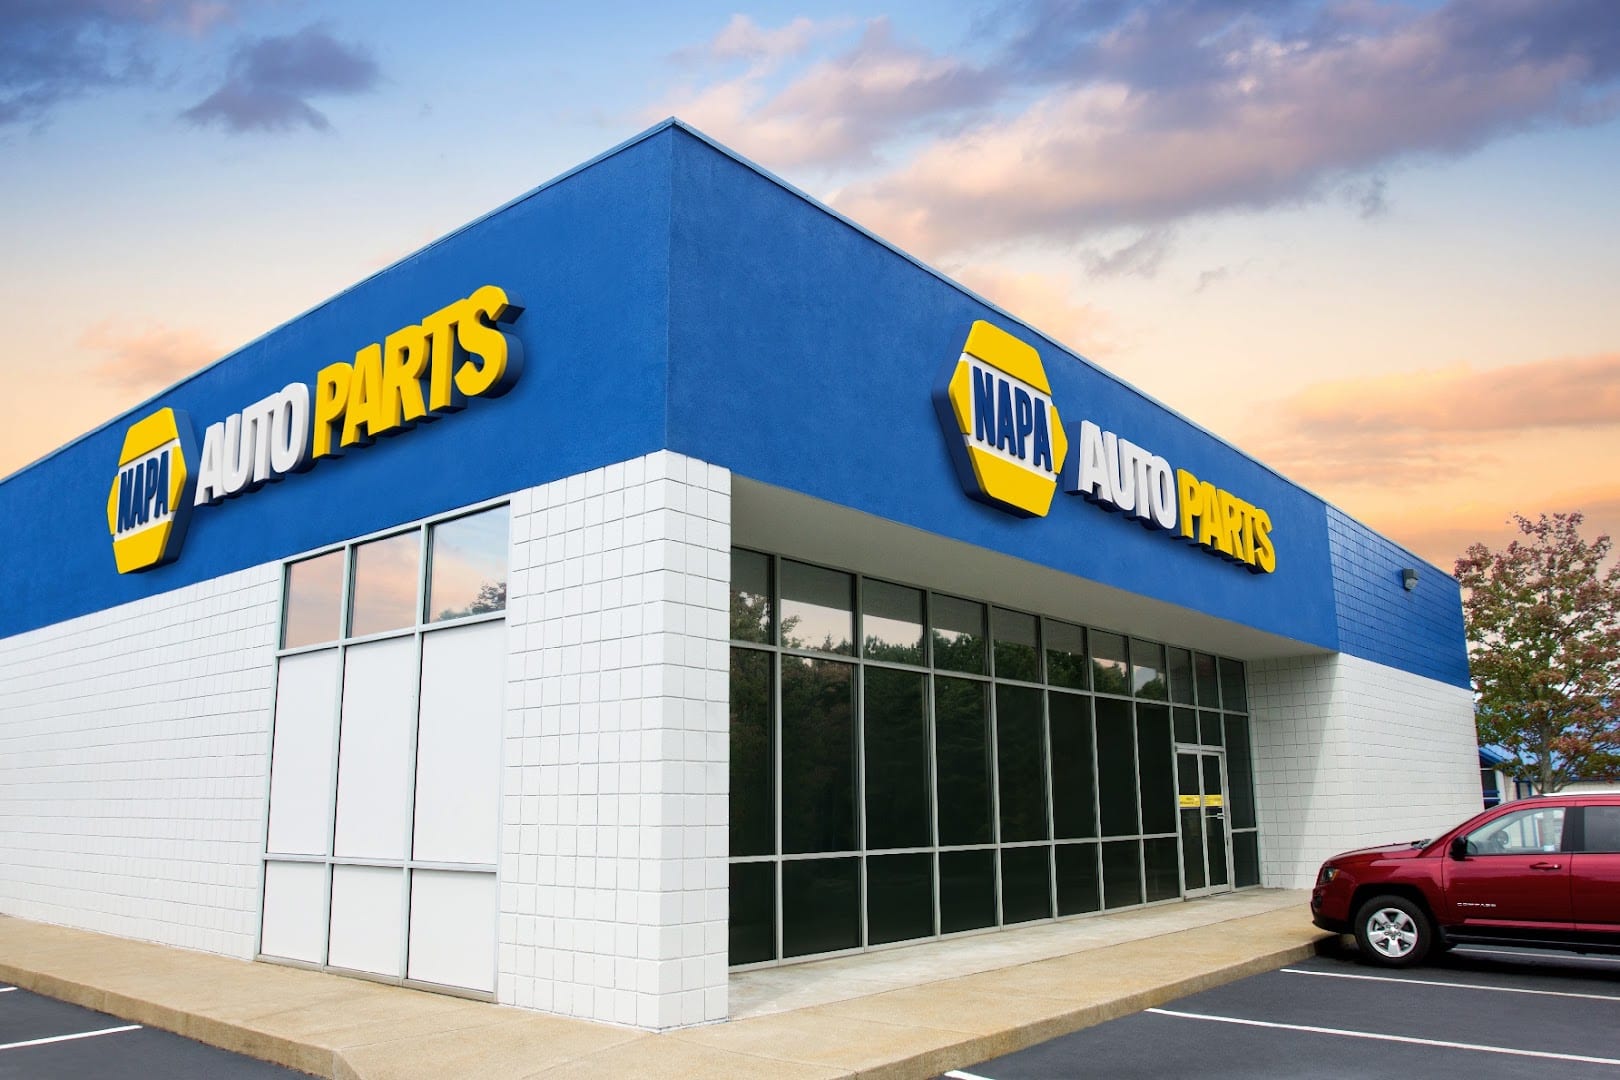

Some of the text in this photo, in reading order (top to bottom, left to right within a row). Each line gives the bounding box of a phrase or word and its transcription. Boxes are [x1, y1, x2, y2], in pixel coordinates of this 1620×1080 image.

[117, 285, 509, 533] NAPA AUTO PARTS
[972, 366, 1276, 574] NAPA AUTO PARTS
